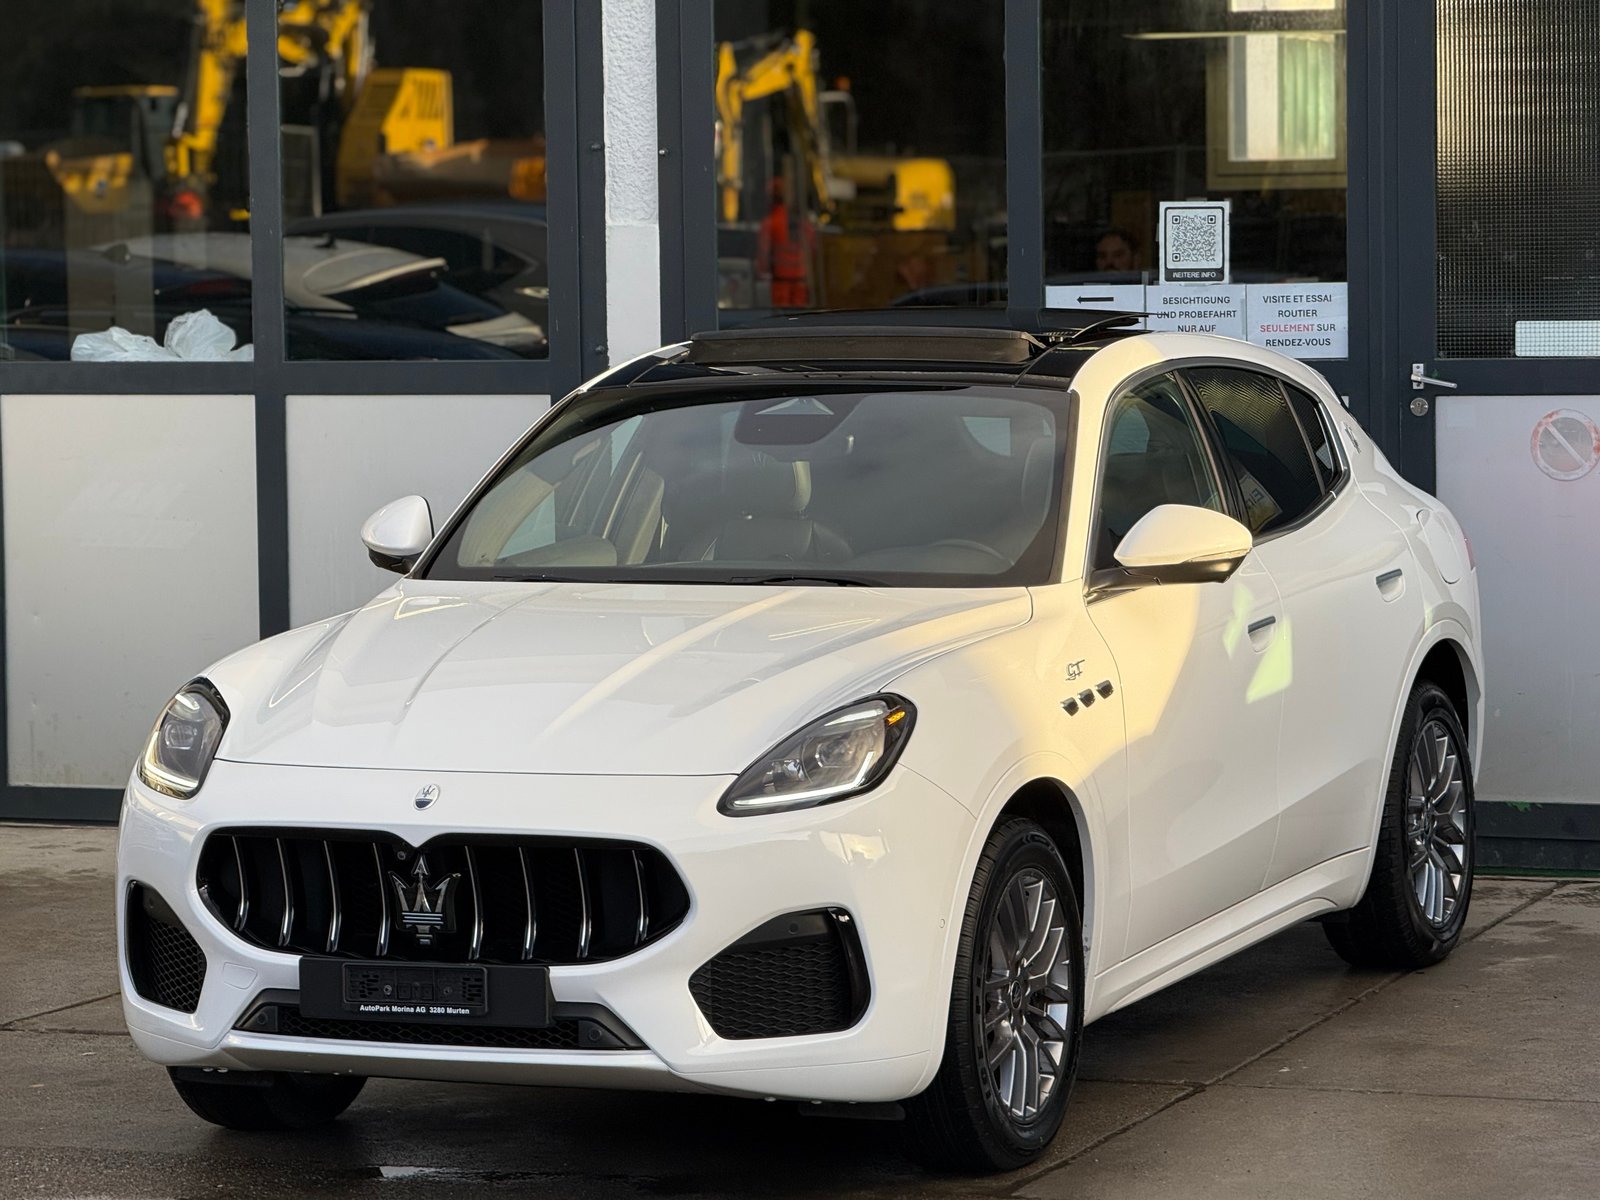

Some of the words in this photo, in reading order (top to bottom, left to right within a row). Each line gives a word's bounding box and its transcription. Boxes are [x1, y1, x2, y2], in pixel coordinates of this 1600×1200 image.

[1162, 296, 1231, 305] BESICHTIGUNG
[1262, 295, 1291, 303] VISITE
[1293, 295, 1304, 303] ET
[1306, 294, 1332, 303] ESSAI
[1156, 311, 1176, 319] UND
[1178, 310, 1237, 318] PROBEFAHRT
[1278, 309, 1318, 318] ROUTIER
[1177, 324, 1197, 333] NUR
[1198, 324, 1217, 332] AUF
[1260, 324, 1315, 333] SEULEMENT
[1316, 323, 1336, 332] SUR
[1265, 338, 1331, 347] RENDEZ-VOUS
[359, 1004, 391, 1012] AutoPark
[391, 1005, 415, 1013] Morina
[429, 1006, 445, 1014] 3280
[446, 1007, 470, 1015] Murten
